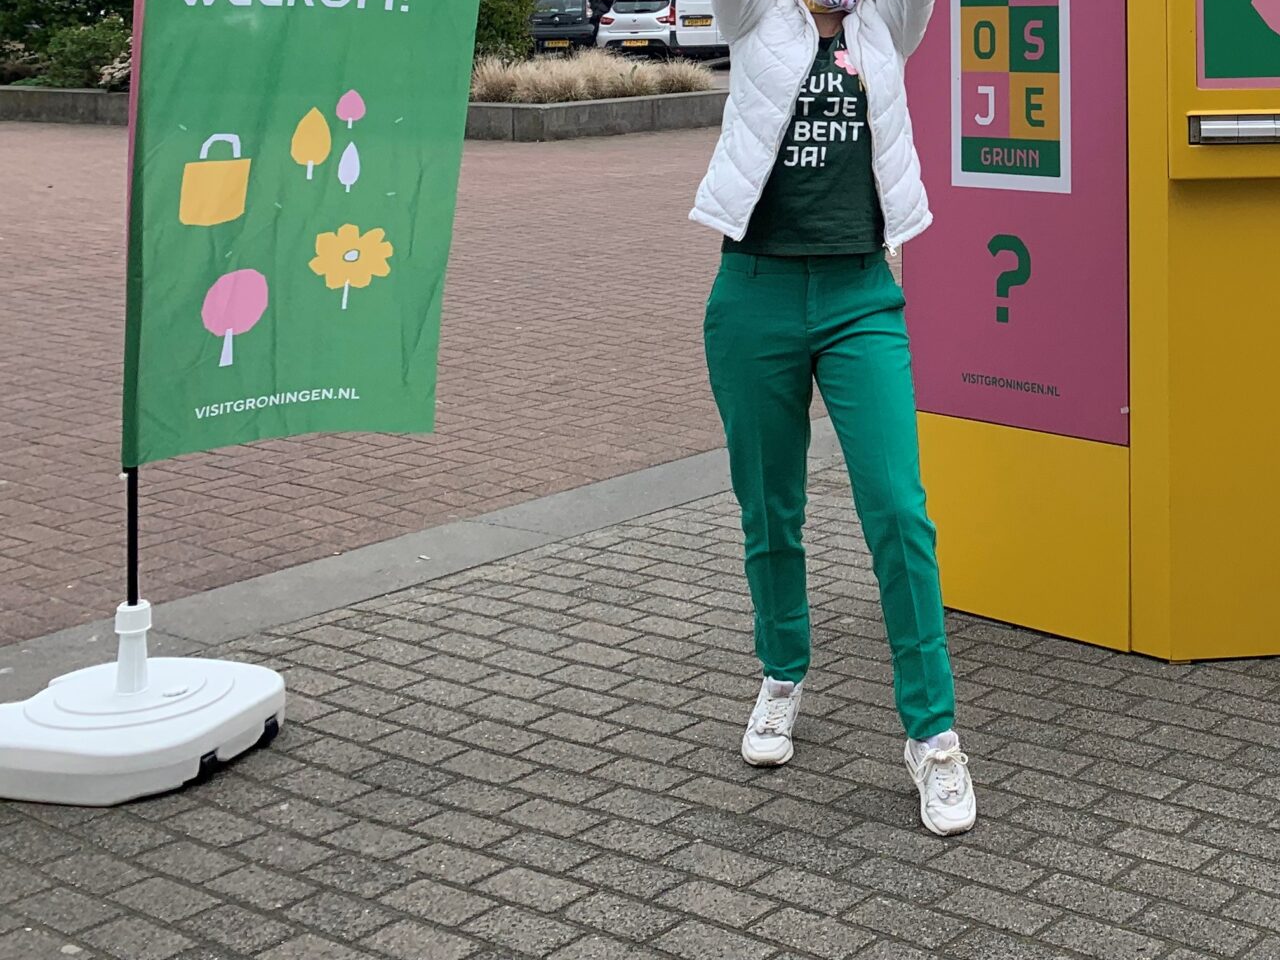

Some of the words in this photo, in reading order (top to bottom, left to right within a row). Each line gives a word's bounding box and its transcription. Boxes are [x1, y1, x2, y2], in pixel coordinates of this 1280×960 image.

[823, 96, 858, 117] JE
[793, 120, 864, 142] BENT
[783, 146, 827, 168] JA!
[981, 147, 1040, 169] GRUNN
[961, 372, 1061, 397] VISITGRONINGEN.NL
[194, 387, 360, 419] VISITGRONINGEN.NL
